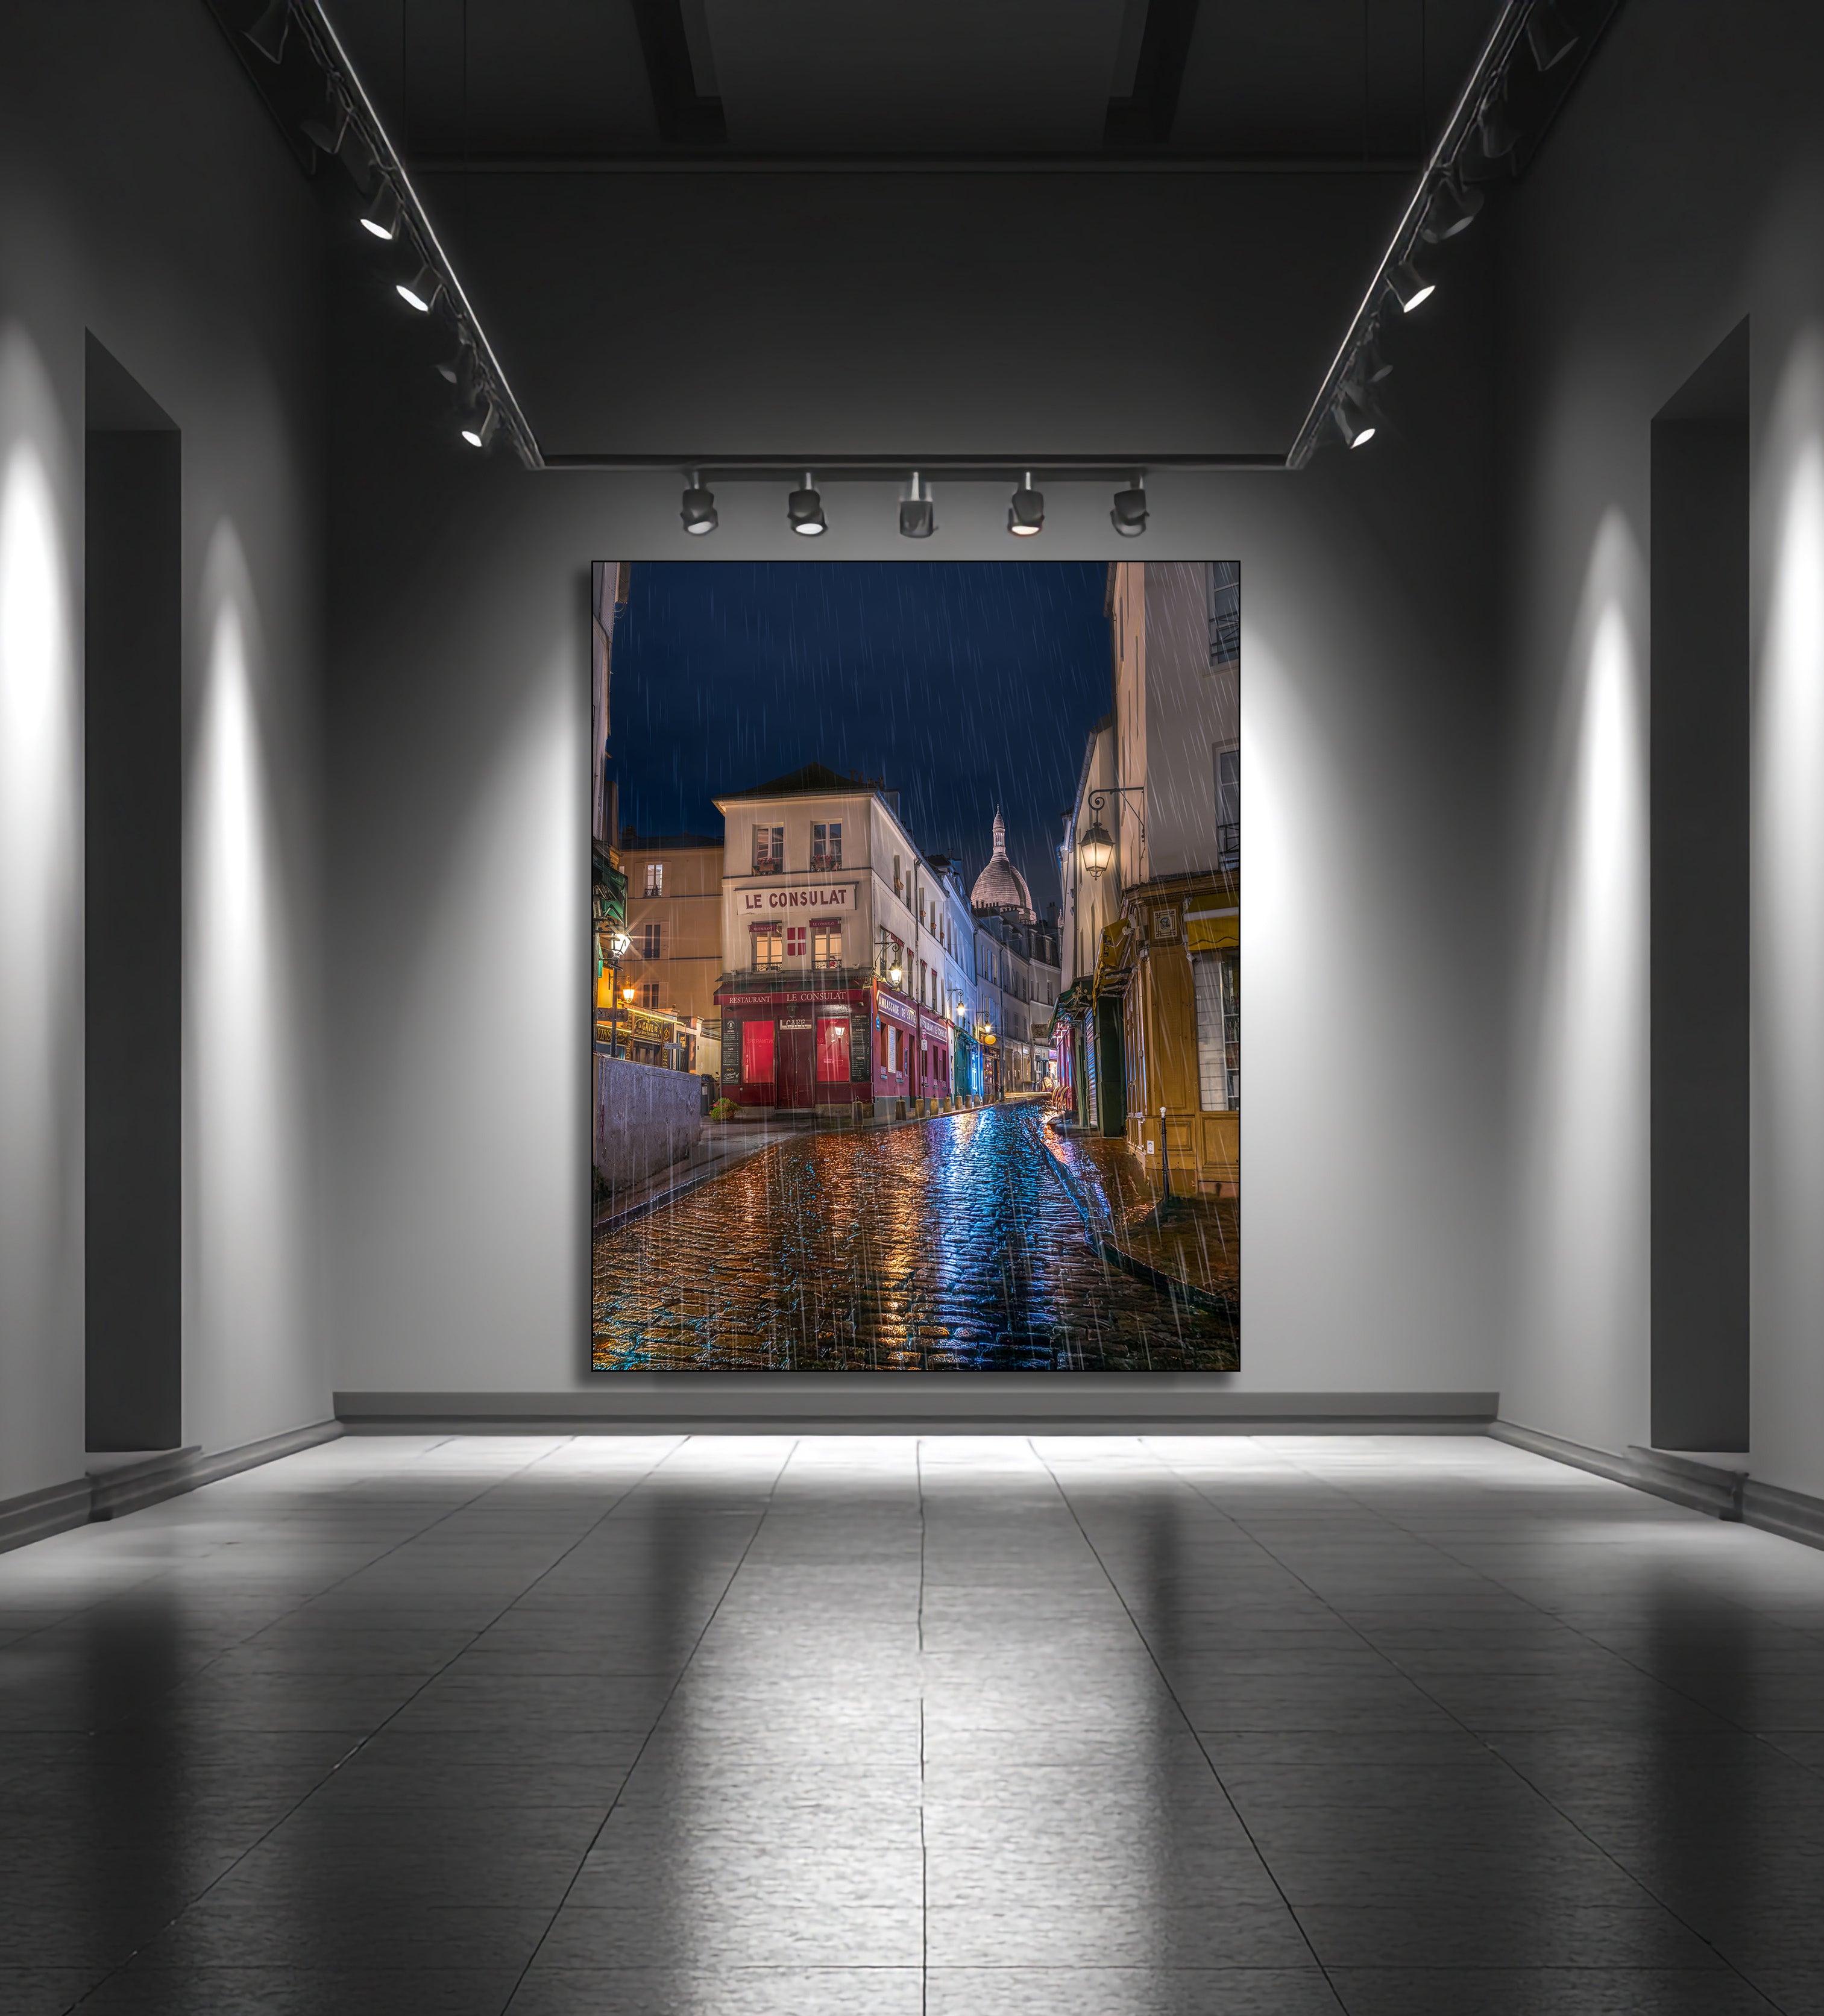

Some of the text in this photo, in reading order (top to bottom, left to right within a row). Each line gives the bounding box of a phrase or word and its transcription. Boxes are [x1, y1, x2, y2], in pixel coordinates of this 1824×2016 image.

[745, 889, 846, 909] LE CONSULAT
[800, 991, 846, 1001] CONSULAT
[878, 996, 899, 1016] AMBASSADE
[901, 1007, 905, 1017] DE
[642, 1022, 653, 1032] CAVE
[934, 1026, 937, 1034] LE
[597, 1028, 612, 1041] VINS
